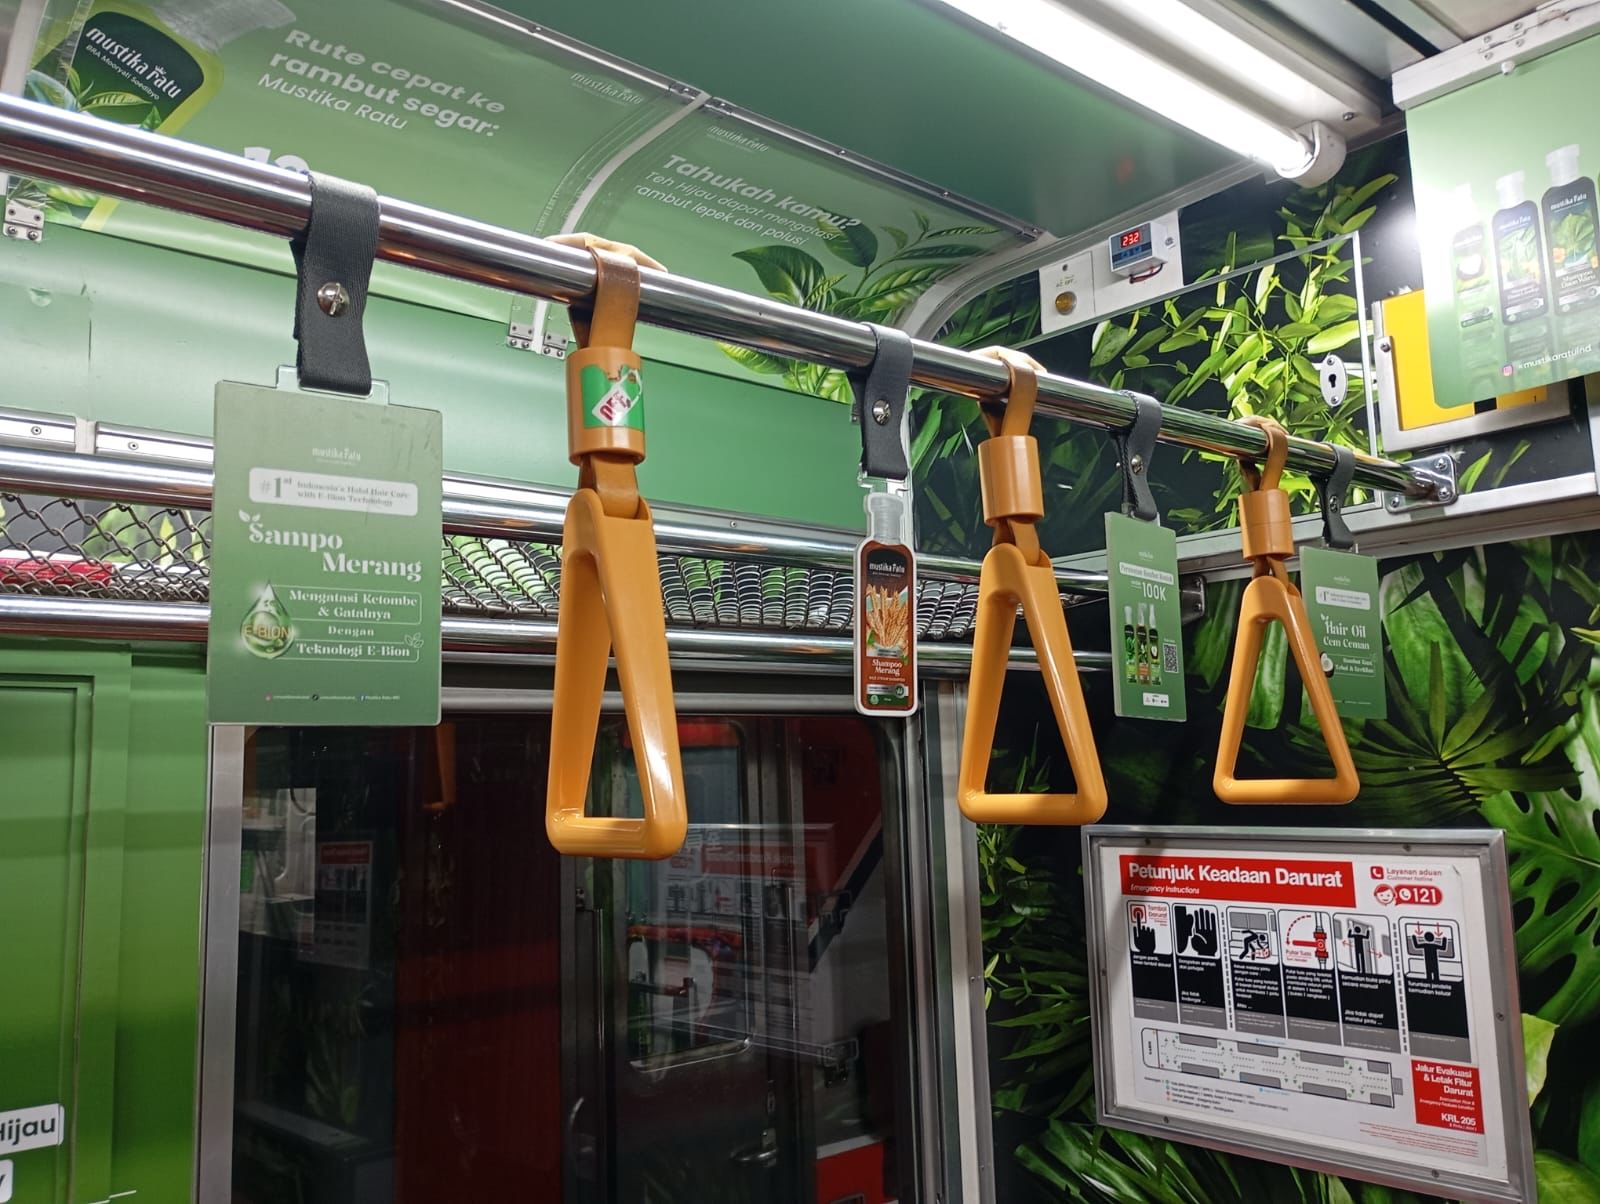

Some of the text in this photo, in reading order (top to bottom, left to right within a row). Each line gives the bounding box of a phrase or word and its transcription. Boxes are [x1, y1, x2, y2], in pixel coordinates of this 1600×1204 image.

[86, 28, 182, 98] mustika ratu
[285, 29, 505, 113] Rute cepat ke
[258, 73, 408, 130] Mustika Ratu
[269, 53, 499, 137] rambut segar:
[662, 154, 862, 230] Tahukah kamu?
[645, 171, 841, 241] Teh Hijau dapat mengatasi
[633, 184, 810, 247] rambut lepek dan polusi
[249, 521, 343, 553] Sampo
[322, 551, 422, 583] Merang
[289, 589, 418, 606] Mengatasi Ketombe
[1142, 581, 1167, 602] 100K
[318, 606, 392, 621] & Gatalnya
[328, 625, 375, 637] Dengan
[1325, 620, 1366, 638] Hair Oil
[296, 642, 410, 657] Teknologi E-Bion
[1128, 862, 1343, 887] Petunjuk Keadaan Darurat
[1386, 867, 1416, 876] Layanan
[1131, 883, 1200, 894] Emergency Instructions
[1412, 888, 1438, 903] 121
[1415, 1063, 1472, 1079] Jalur Evakuasi
[1424, 1073, 1473, 1087] & Letak Fitur
[1443, 1085, 1474, 1097] Darurat
[1441, 1112, 1477, 1126] KRL 205
